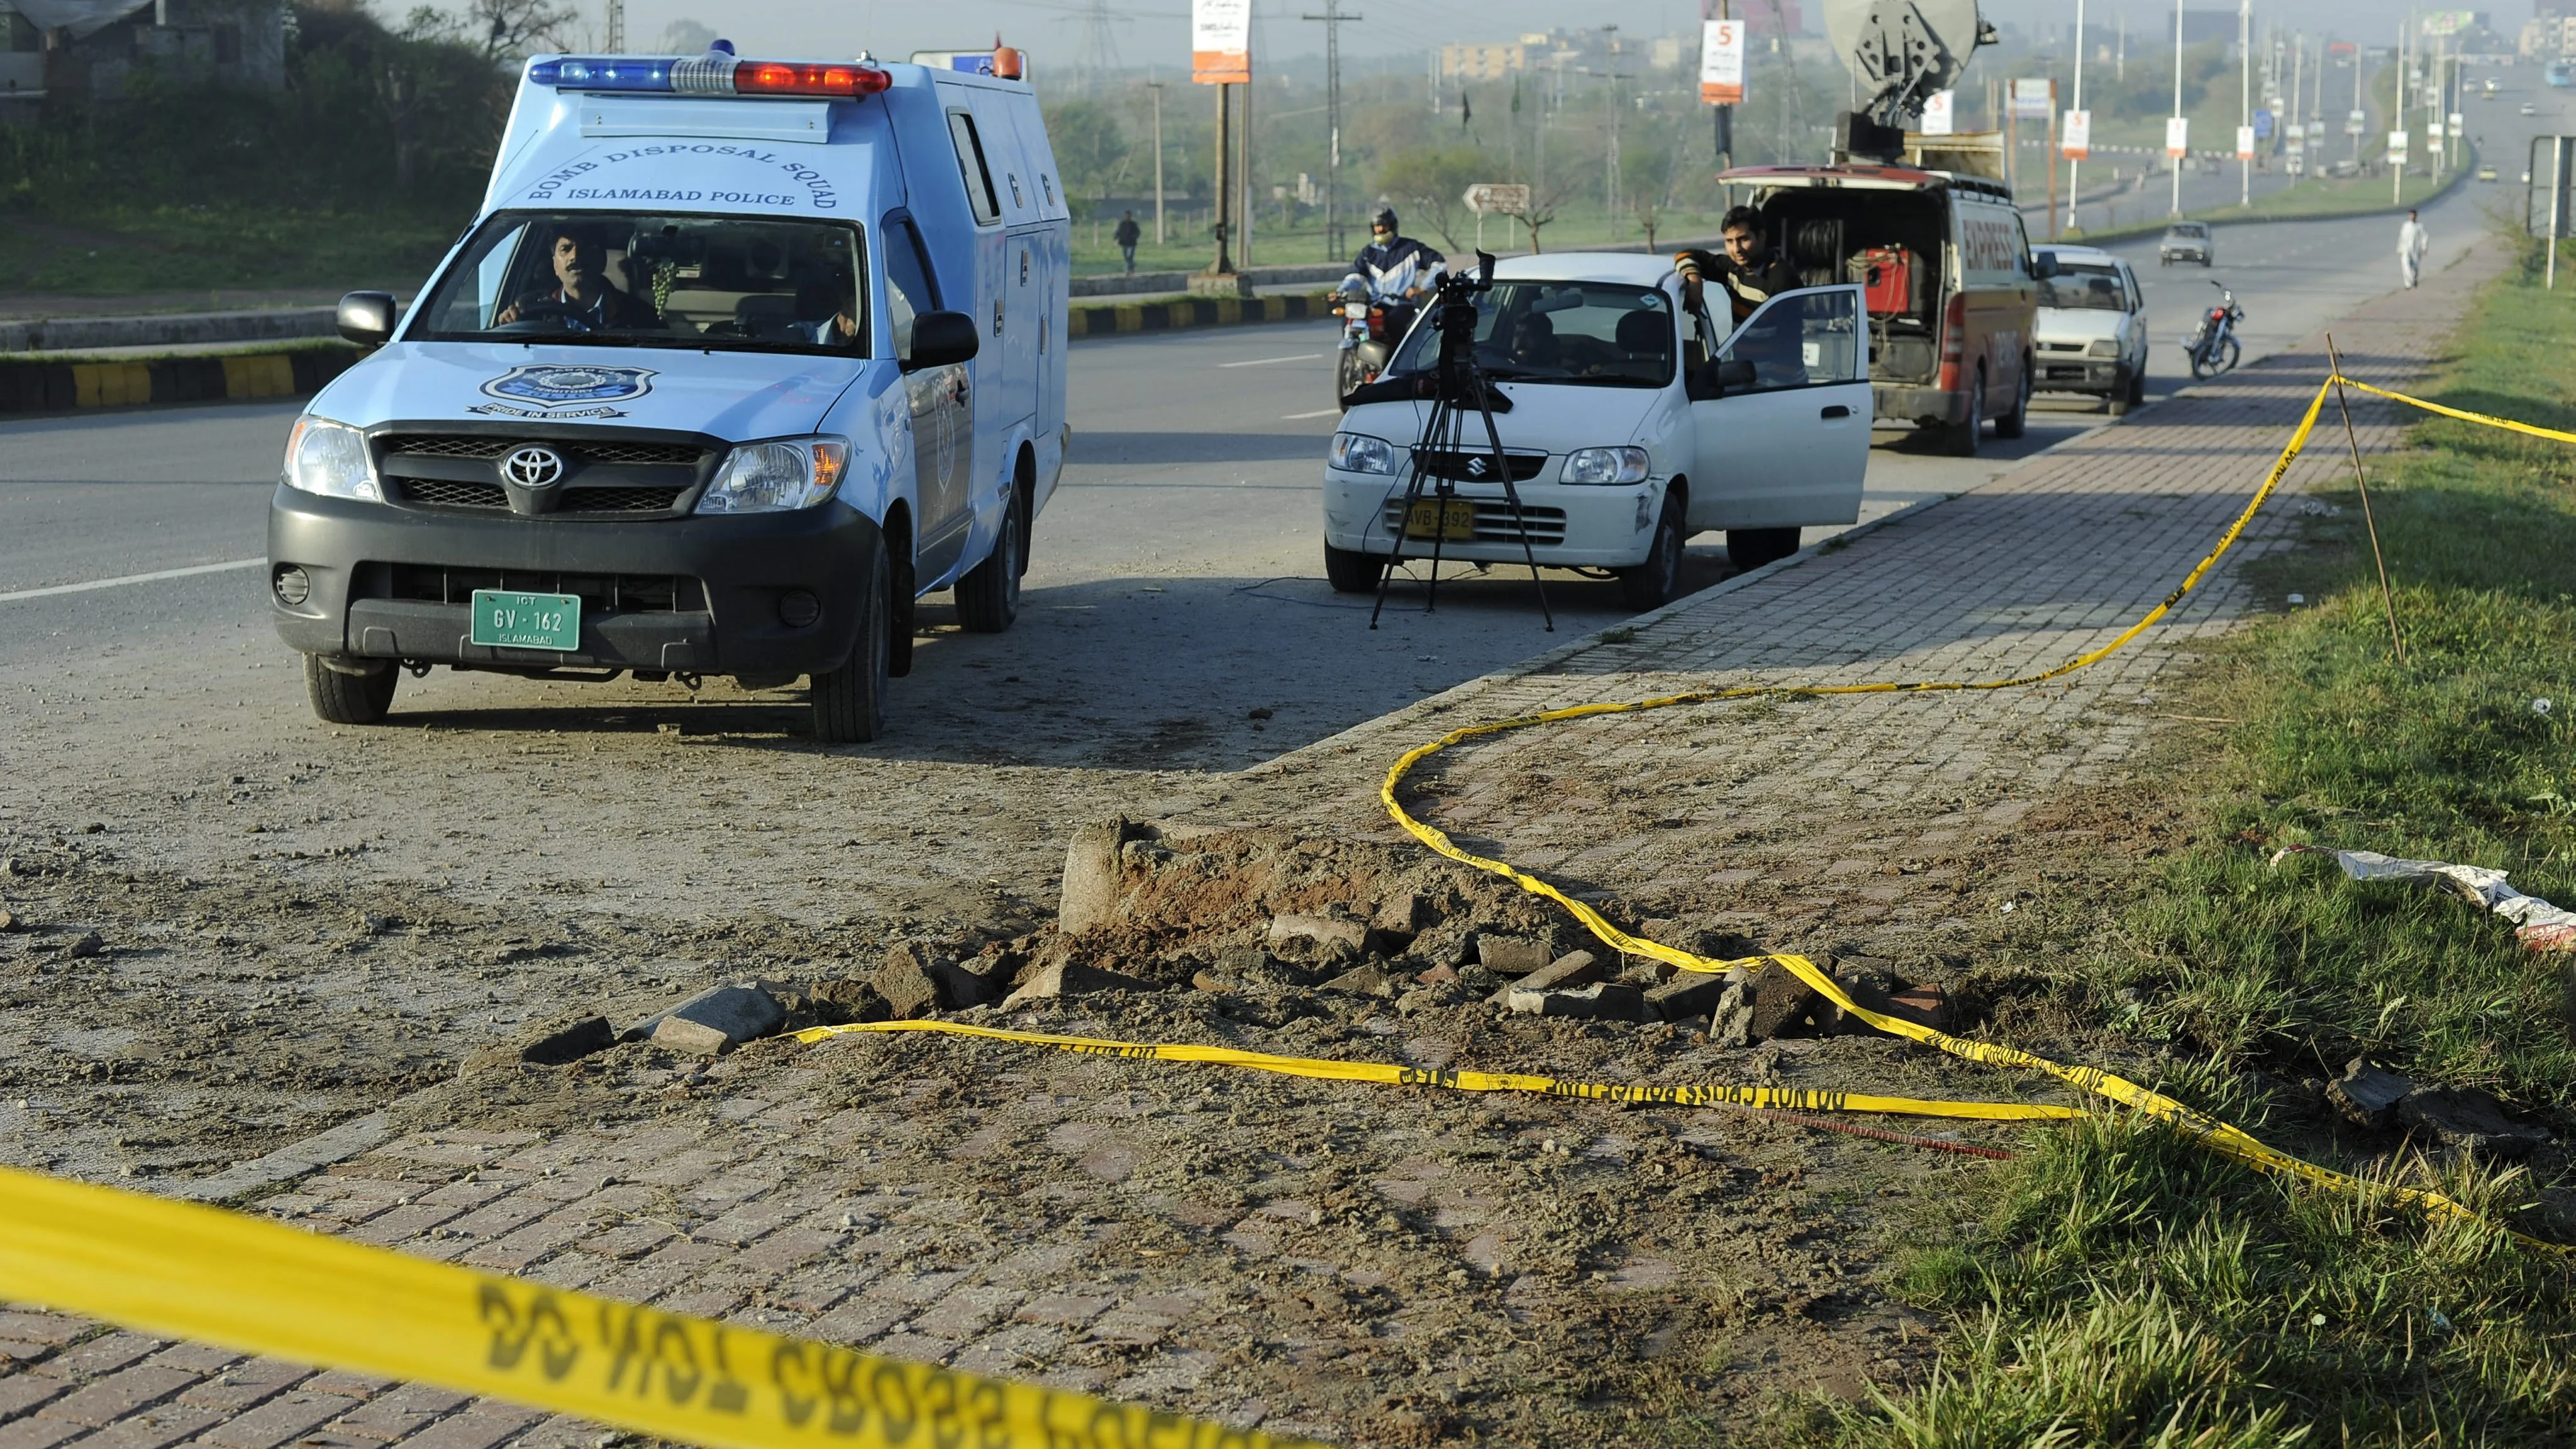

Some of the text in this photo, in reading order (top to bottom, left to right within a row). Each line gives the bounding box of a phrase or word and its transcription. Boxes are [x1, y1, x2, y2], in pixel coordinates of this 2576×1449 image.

[1718, 25, 1733, 45] 5
[528, 145, 836, 209] BOMB DISPOSAL SQUAD
[567, 189, 795, 206] ISLAMABAD POLICE
[519, 389, 603, 399] POLICE
[486, 403, 525, 418] PRIDE
[546, 406, 612, 419] SERVICE
[516, 596, 536, 606] ICT
[499, 634, 553, 645] ISLAMABAD
